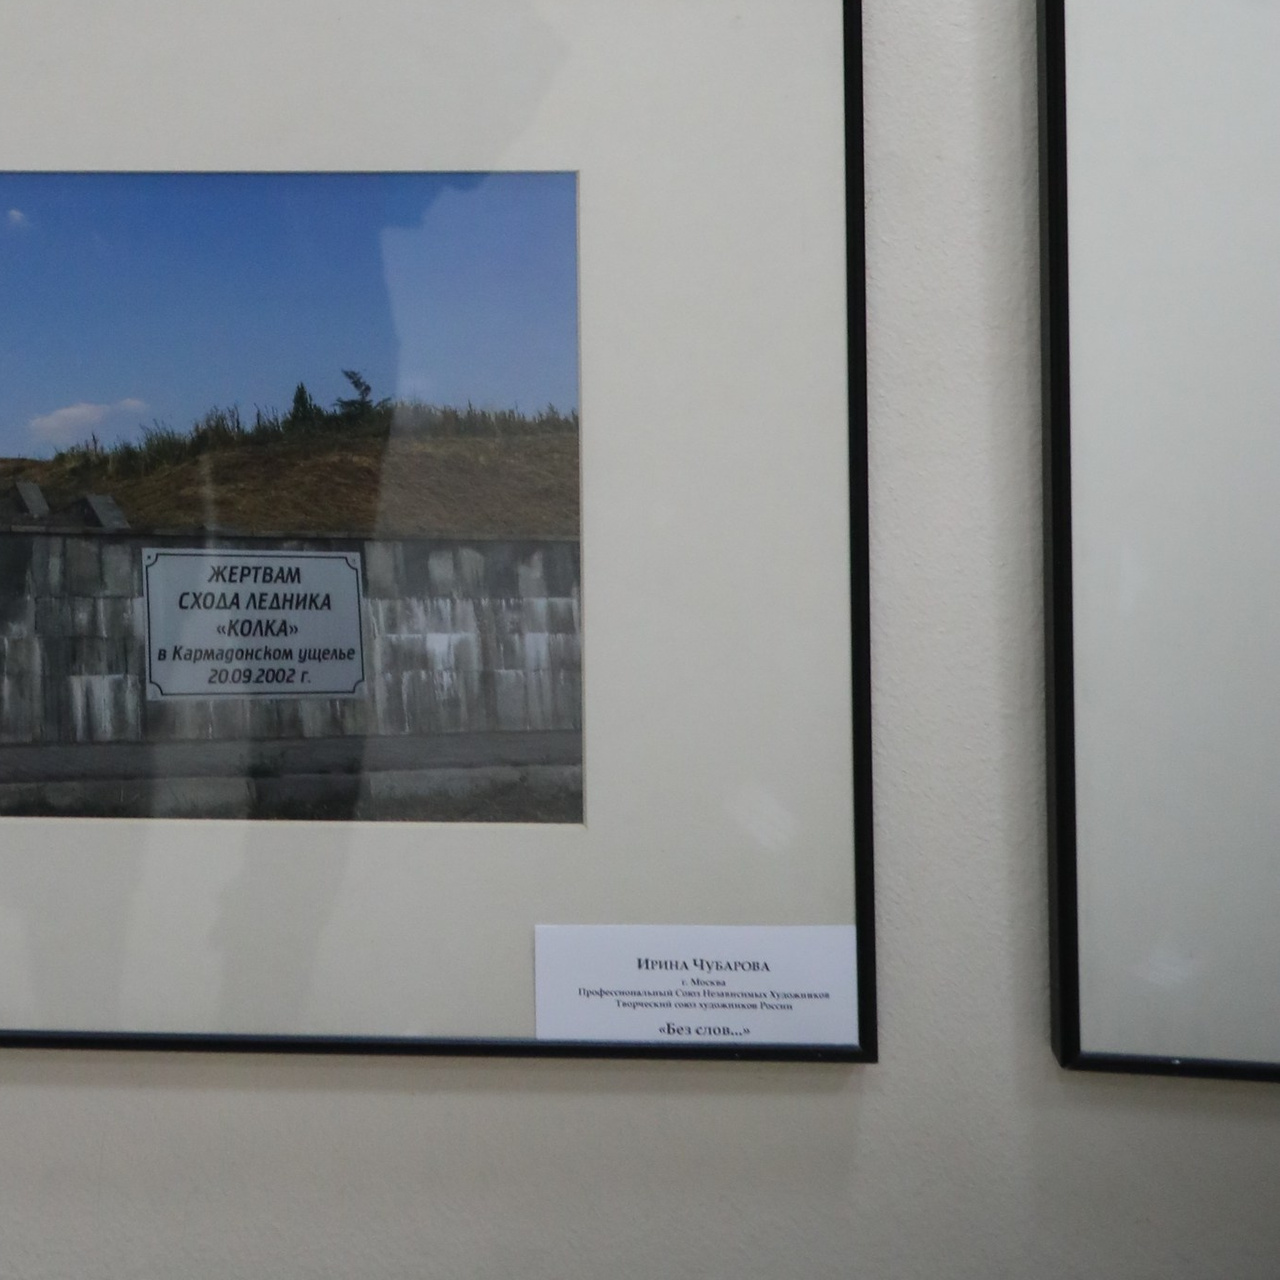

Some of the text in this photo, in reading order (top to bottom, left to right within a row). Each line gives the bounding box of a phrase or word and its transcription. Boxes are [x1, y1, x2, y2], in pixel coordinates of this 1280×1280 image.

[208, 566, 301, 584] ЖЕРТВАМ
[179, 592, 332, 610] СХОДА ЛЕДНИКА
[217, 619, 298, 637] «КОЛКА»
[158, 645, 356, 663] в Кармадонском ущелье
[208, 669, 311, 684] 20.09.2002 г.
[691, 978, 726, 986] Москва
[615, 1000, 672, 1009] Творческий
[699, 1001, 758, 1011] художников
[760, 1002, 793, 1010] России
[659, 1022, 751, 1036] «Без слов...»
